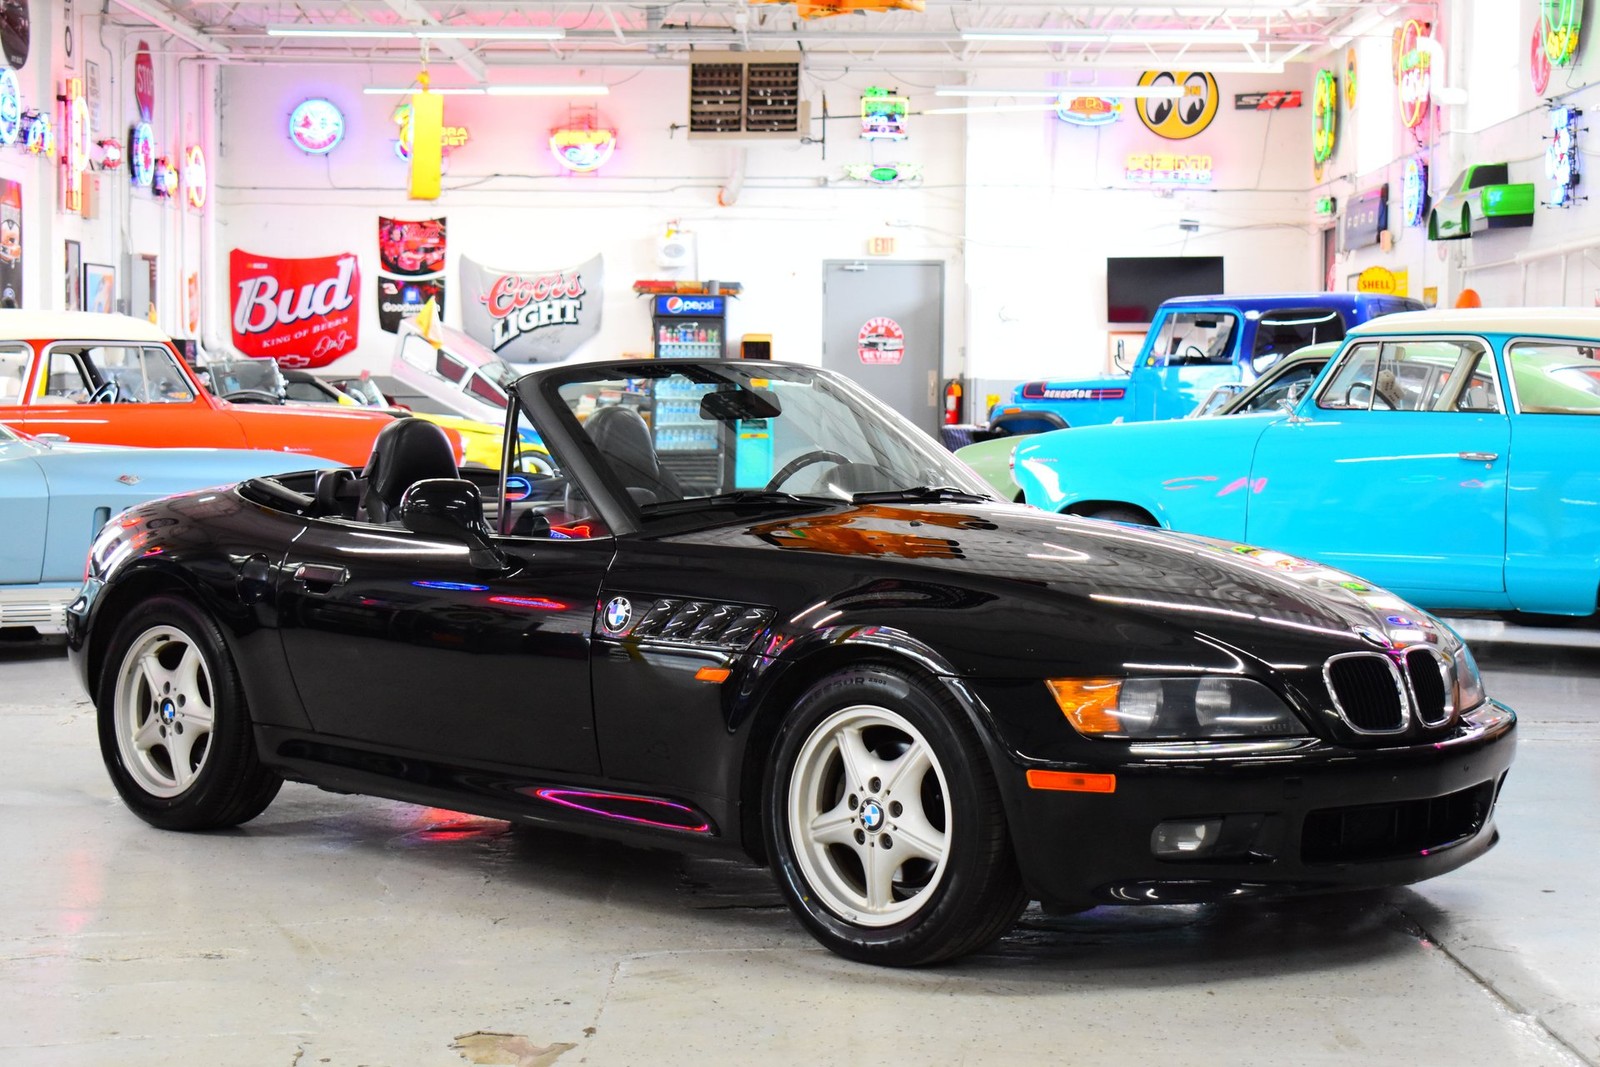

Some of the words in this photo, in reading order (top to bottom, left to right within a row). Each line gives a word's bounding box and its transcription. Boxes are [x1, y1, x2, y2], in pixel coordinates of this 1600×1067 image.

[137, 64, 154, 96] STOP
[1237, 94, 1300, 107] SRT
[440, 127, 467, 136] BRA
[1347, 210, 1374, 229] FORD
[874, 237, 895, 253] EXIT
[1362, 280, 1391, 290] SHELL
[234, 257, 355, 335] Bud
[480, 271, 587, 318] Coors
[683, 300, 714, 312] pepsi
[262, 334, 291, 348] KING
[294, 328, 309, 339] OF
[312, 316, 349, 334] BEERS
[492, 299, 583, 351] LIGHT
[1043, 389, 1093, 399] RENEGADE
